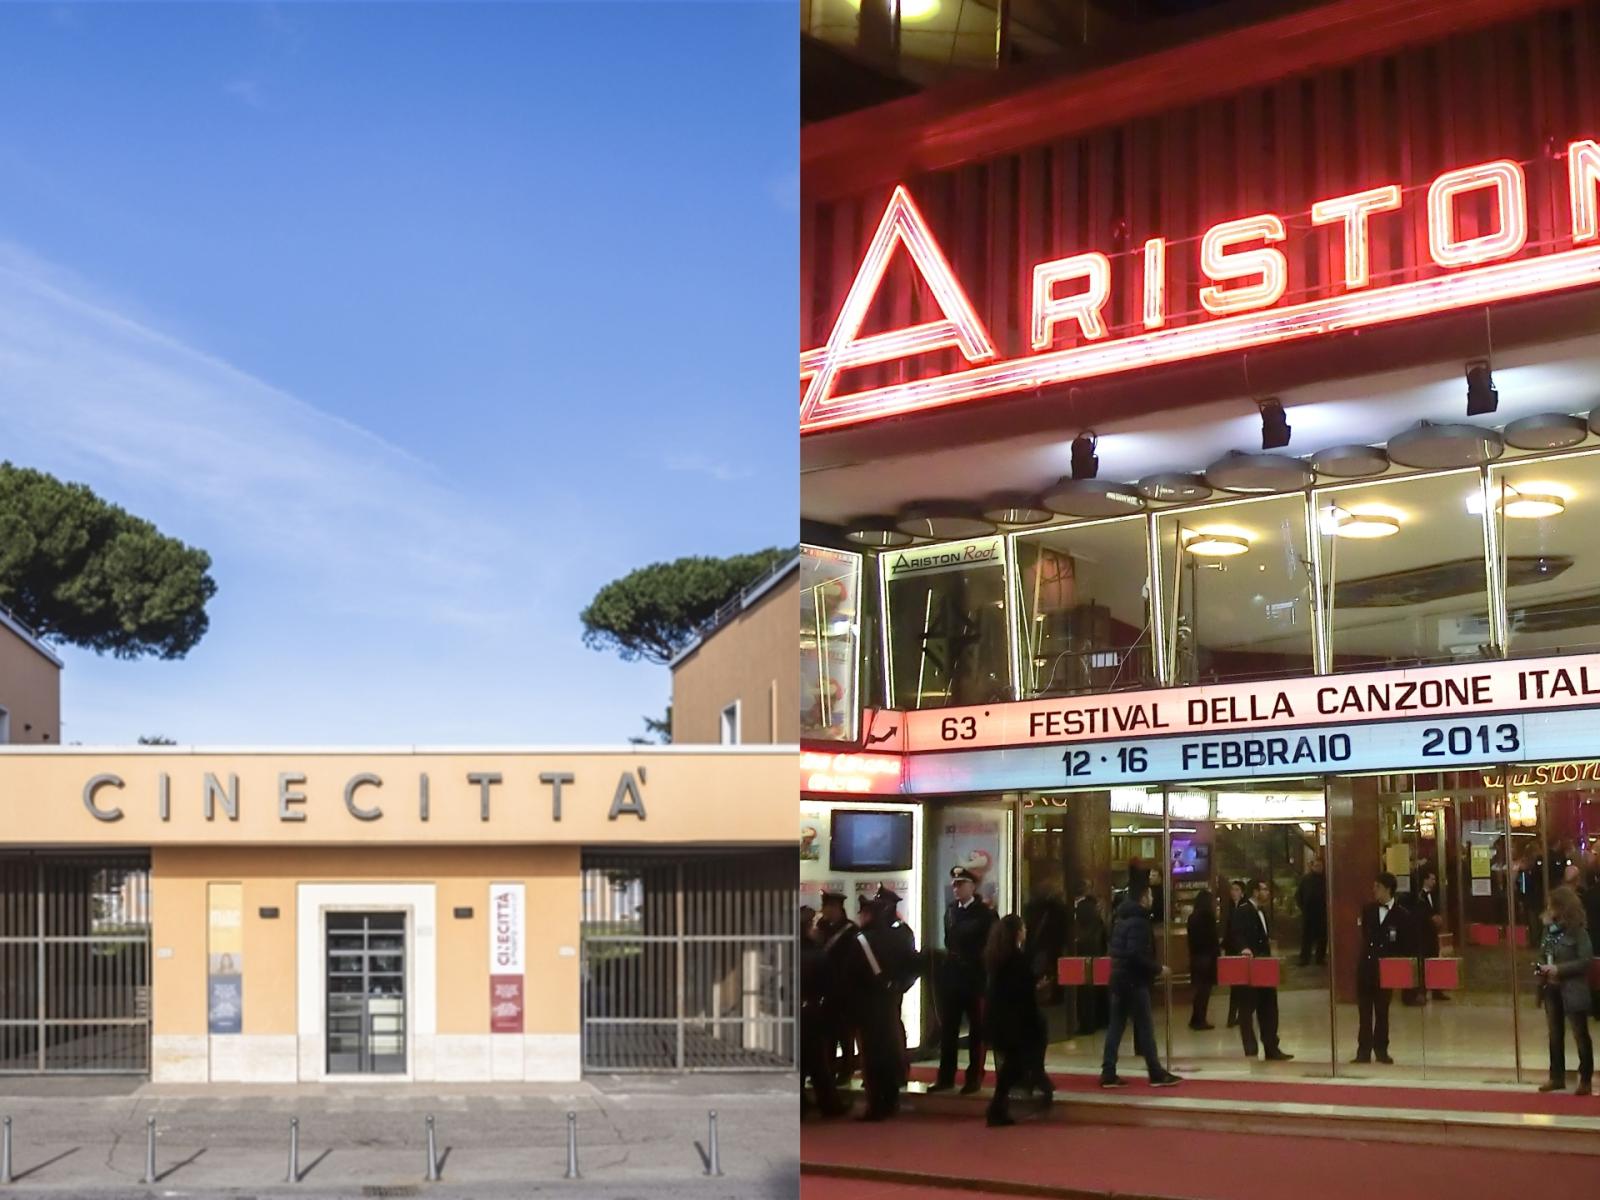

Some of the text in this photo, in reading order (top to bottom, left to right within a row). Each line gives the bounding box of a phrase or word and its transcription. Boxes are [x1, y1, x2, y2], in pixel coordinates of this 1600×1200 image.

[963, 540, 999, 561] Roof
[1029, 703, 1169, 737] FESTIVAL
[1188, 692, 1295, 725] DELLA
[1317, 675, 1493, 715] CANZONE
[1518, 666, 1600, 700] ITAL
[1182, 733, 1351, 771] FEBBRAIO
[1422, 723, 1520, 757] 2013
